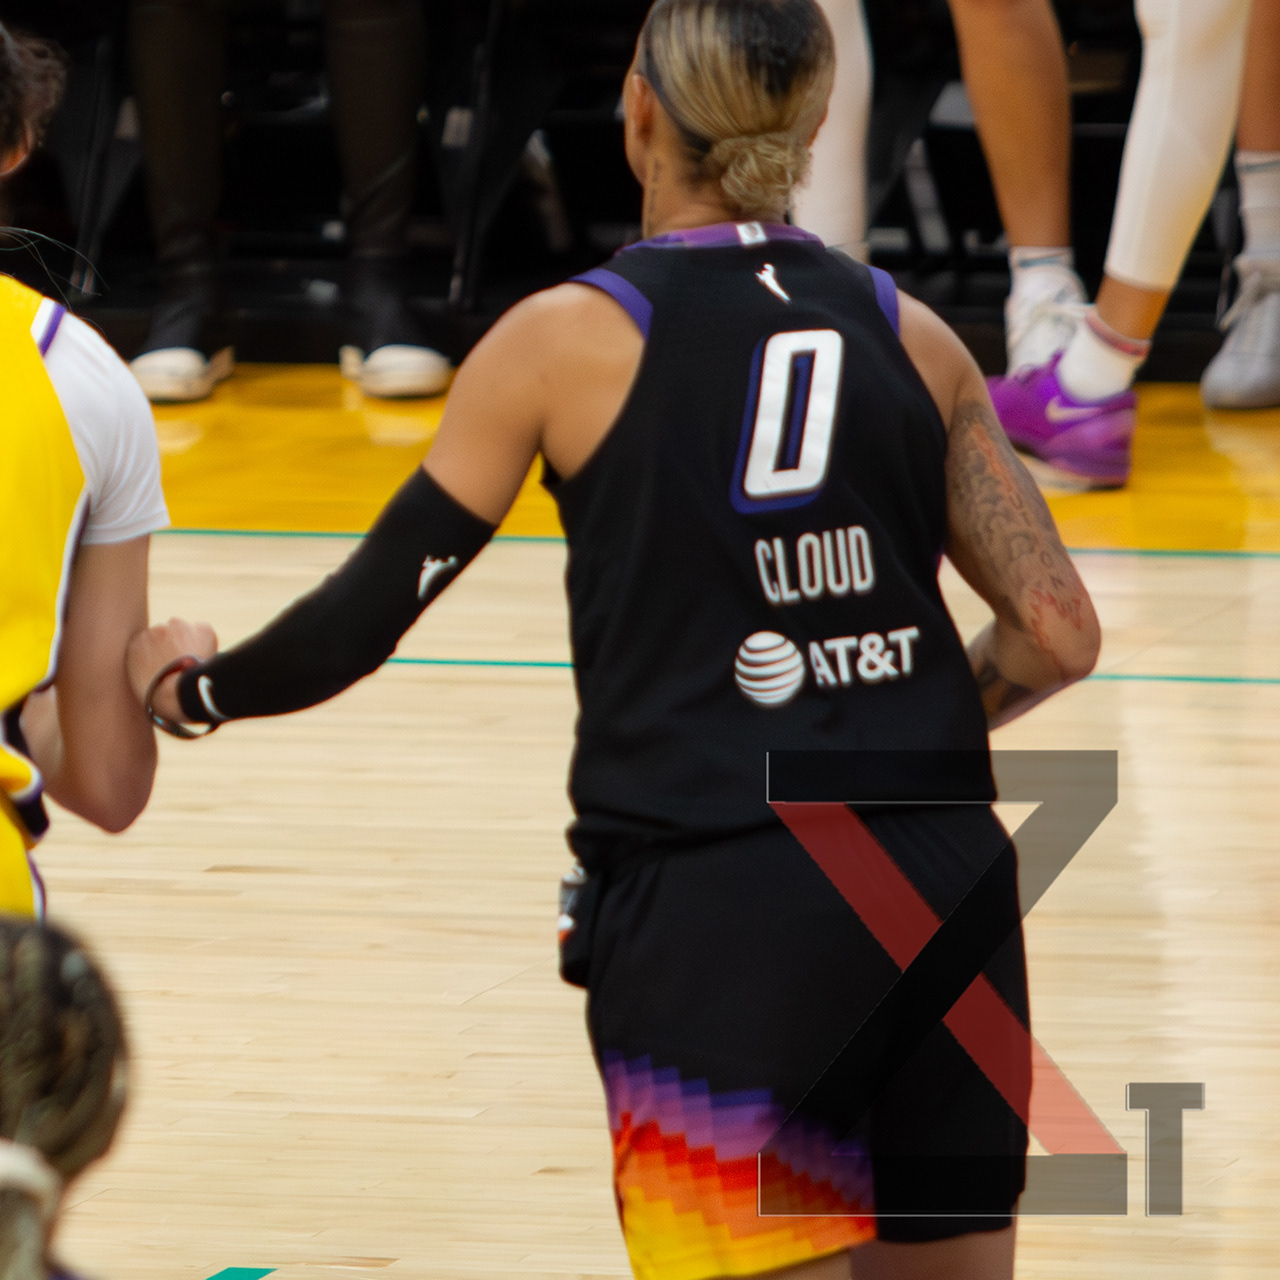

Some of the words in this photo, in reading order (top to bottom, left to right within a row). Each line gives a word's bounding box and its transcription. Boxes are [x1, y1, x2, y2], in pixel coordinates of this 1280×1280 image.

[731, 328, 844, 515] 0
[754, 525, 876, 606] CLOUD
[808, 625, 921, 689] AT&T
